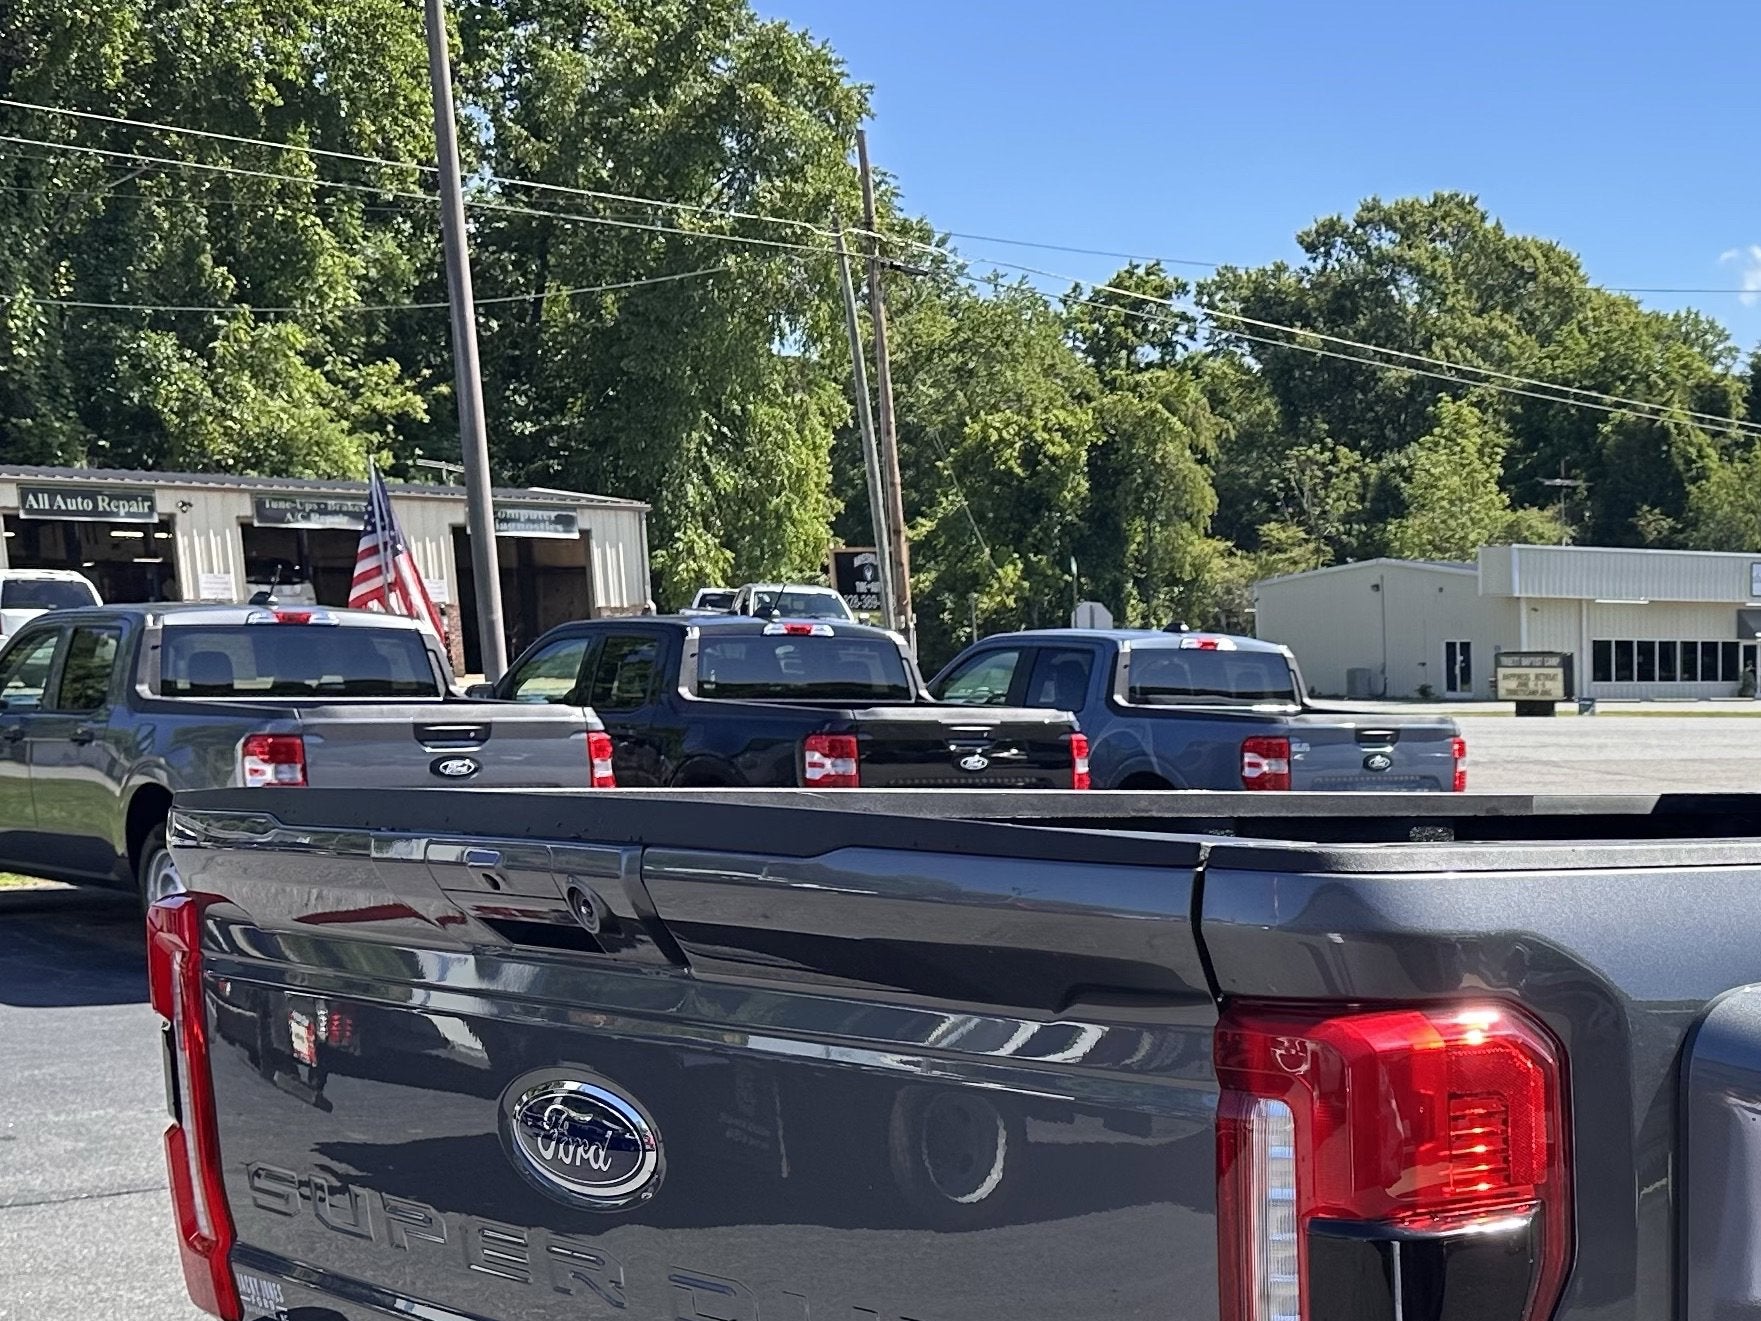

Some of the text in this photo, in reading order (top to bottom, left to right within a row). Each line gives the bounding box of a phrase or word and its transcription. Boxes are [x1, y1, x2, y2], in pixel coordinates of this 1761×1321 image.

[25, 492, 152, 516] All Auto Repair
[497, 509, 555, 522] omputer
[535, 1095, 613, 1172] Ford
[245, 1159, 627, 1310] SUPER
